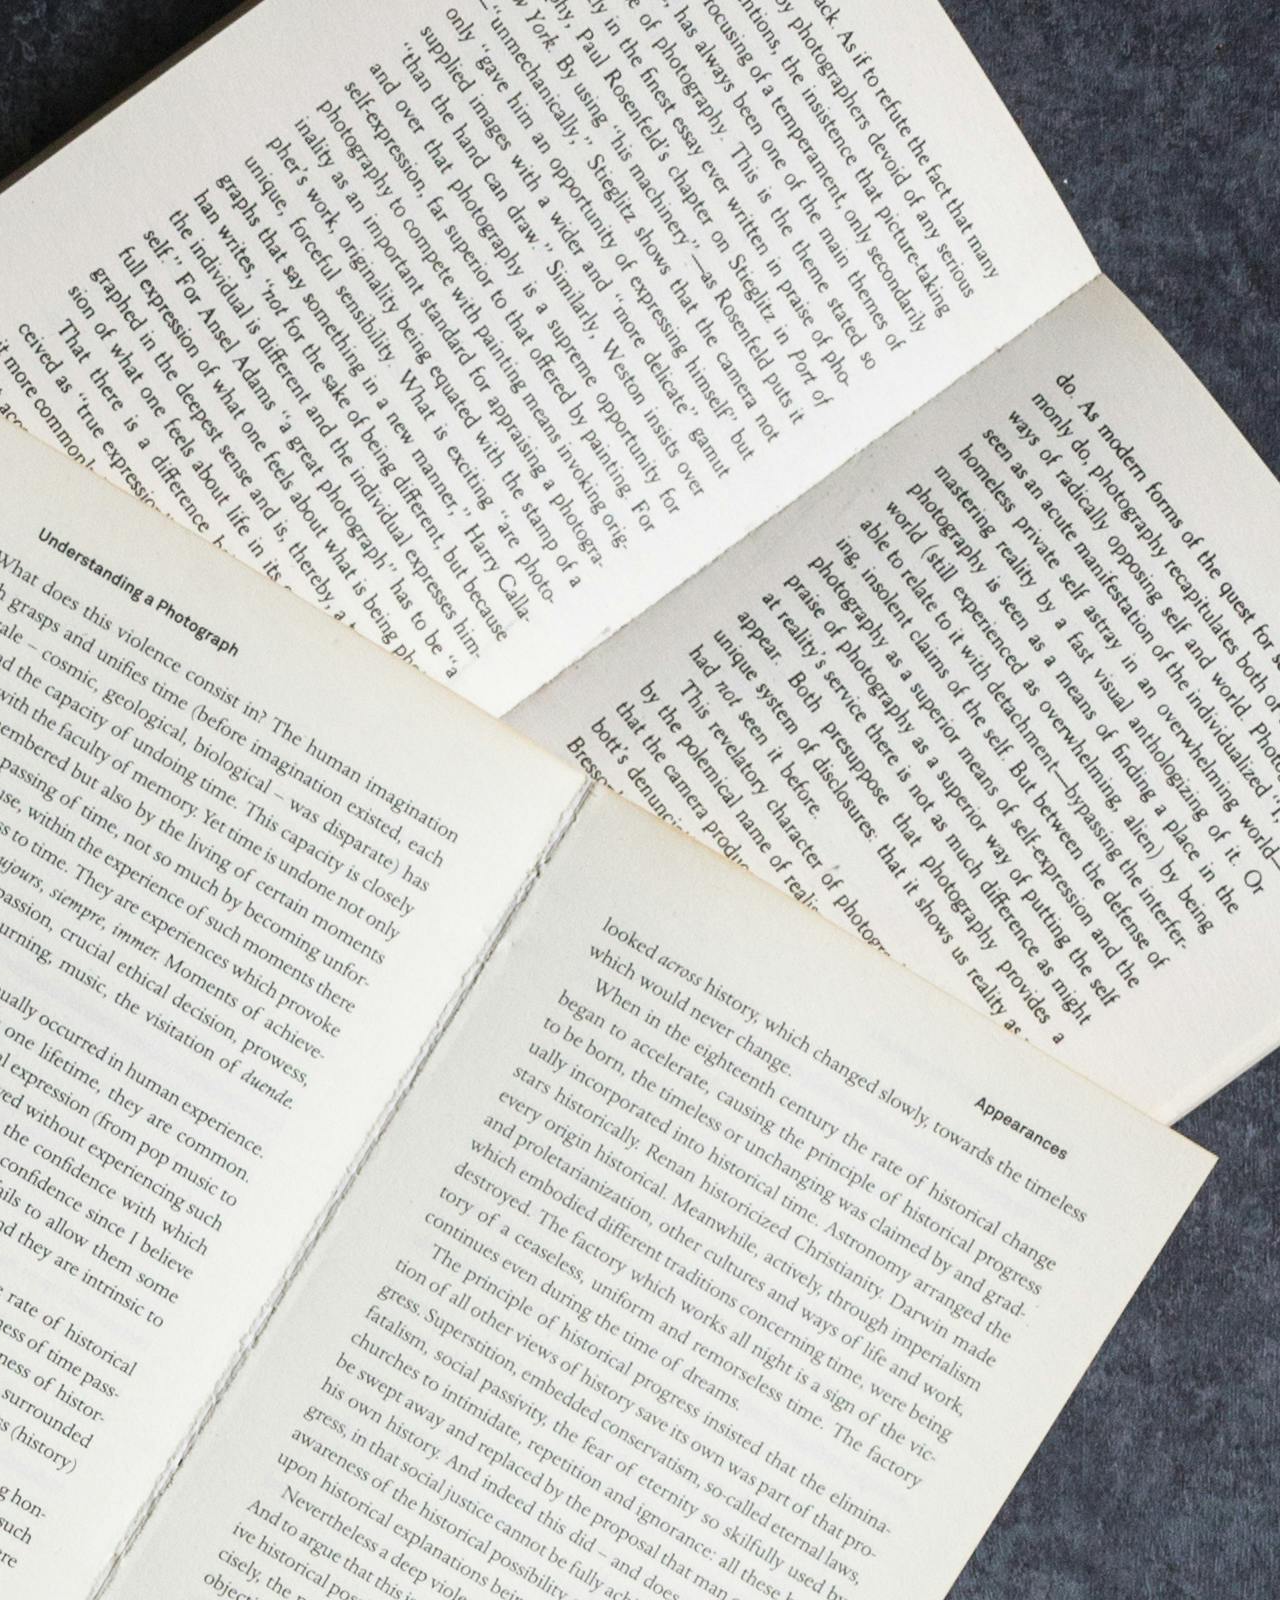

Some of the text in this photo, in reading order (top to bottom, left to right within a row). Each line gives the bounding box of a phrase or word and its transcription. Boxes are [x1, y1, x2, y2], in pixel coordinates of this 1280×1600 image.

[343, 80, 655, 532] self-expression, far superior to that offered by painting. For
[419, 25, 477, 94] supplied
[467, 92, 512, 152] images
[510, 153, 542, 193] with
[536, 195, 551, 209] a
[549, 210, 585, 256] wider
[581, 259, 614, 293] and
[687, 426, 730, 479] gamut
[37, 526, 239, 658] Understanding a Photograph
[41, 579, 80, 611] does
[81, 604, 113, 631] this
[117, 625, 182, 673] violence
[184, 669, 241, 709] consist
[241, 700, 268, 724] in?
[271, 715, 303, 747] The
[304, 736, 362, 784] human
[363, 775, 459, 844] imagination
[687, 642, 821, 820] had not seen it before.
[933, 464, 1265, 895] mastering reality by a fast visual anthologizing of it. Or
[736, 610, 1065, 1045] appear. Both presuppose that photography provides a
[57, 959, 107, 999] music,
[113, 991, 141, 1015] the
[145, 1009, 215, 1062] visitation
[217, 1056, 243, 1074] of
[239, 1068, 294, 1110] duende.
[973, 1096, 1068, 1161] Appearances
[482, 1115, 963, 1418] and proletarianization, other cultures and ways of life and work,
[511, 1066, 997, 1368] stars historically. Renan historicized Christianity. Darwin made
[276, 1451, 318, 1485] upon
[318, 1473, 395, 1528] historical
[392, 1523, 489, 1587] explanations
